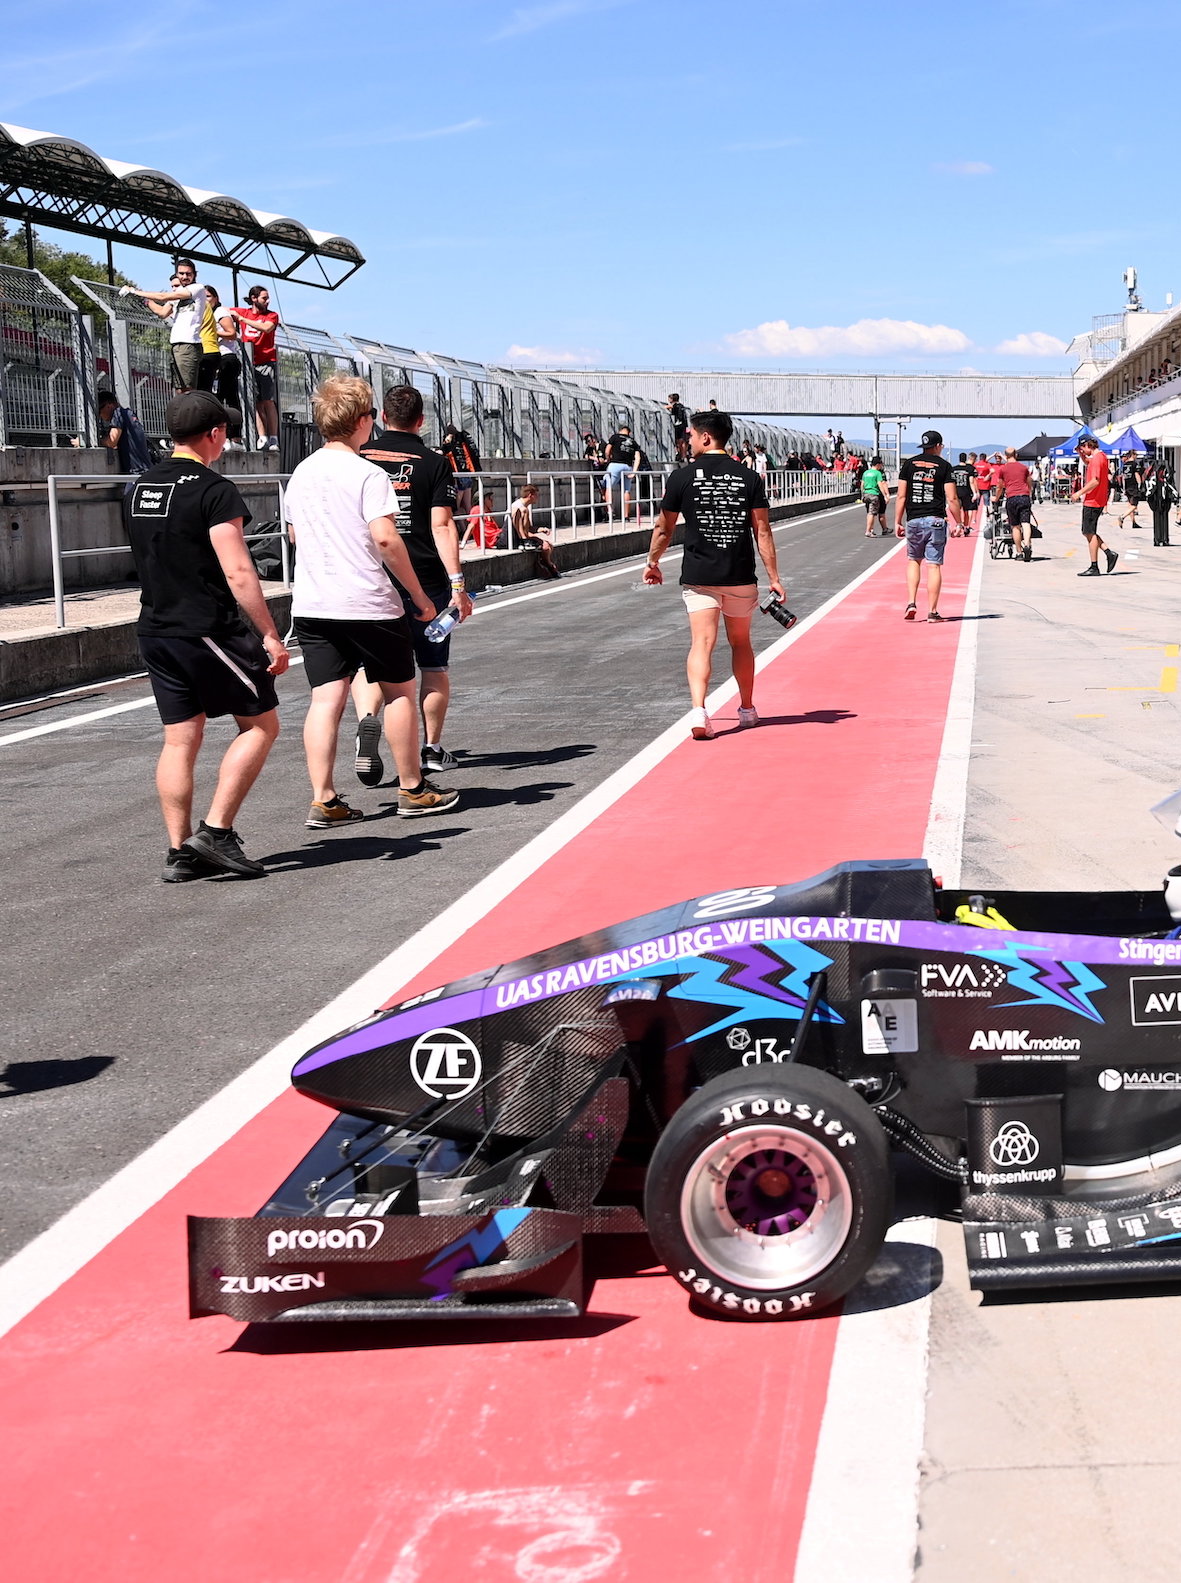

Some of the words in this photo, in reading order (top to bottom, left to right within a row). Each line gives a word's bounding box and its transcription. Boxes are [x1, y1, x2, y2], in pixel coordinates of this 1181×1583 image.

[141, 490, 163, 500] Sleep
[495, 980, 544, 1008] UAS
[545, 916, 901, 992] RAVENSBURG-WEINGARTEN
[921, 964, 979, 987] FVA
[921, 988, 956, 997] Software
[957, 989, 964, 997] &
[964, 988, 992, 997] Service
[969, 1030, 1081, 1050] AMKmotion
[422, 1042, 468, 1085] ZF
[719, 1098, 857, 1147] Hoosier
[972, 1167, 1057, 1186] thyssenkrupp
[267, 1226, 365, 1257] proion
[220, 1271, 325, 1294] ZUKEN
[678, 1268, 816, 1315] Hoosier
